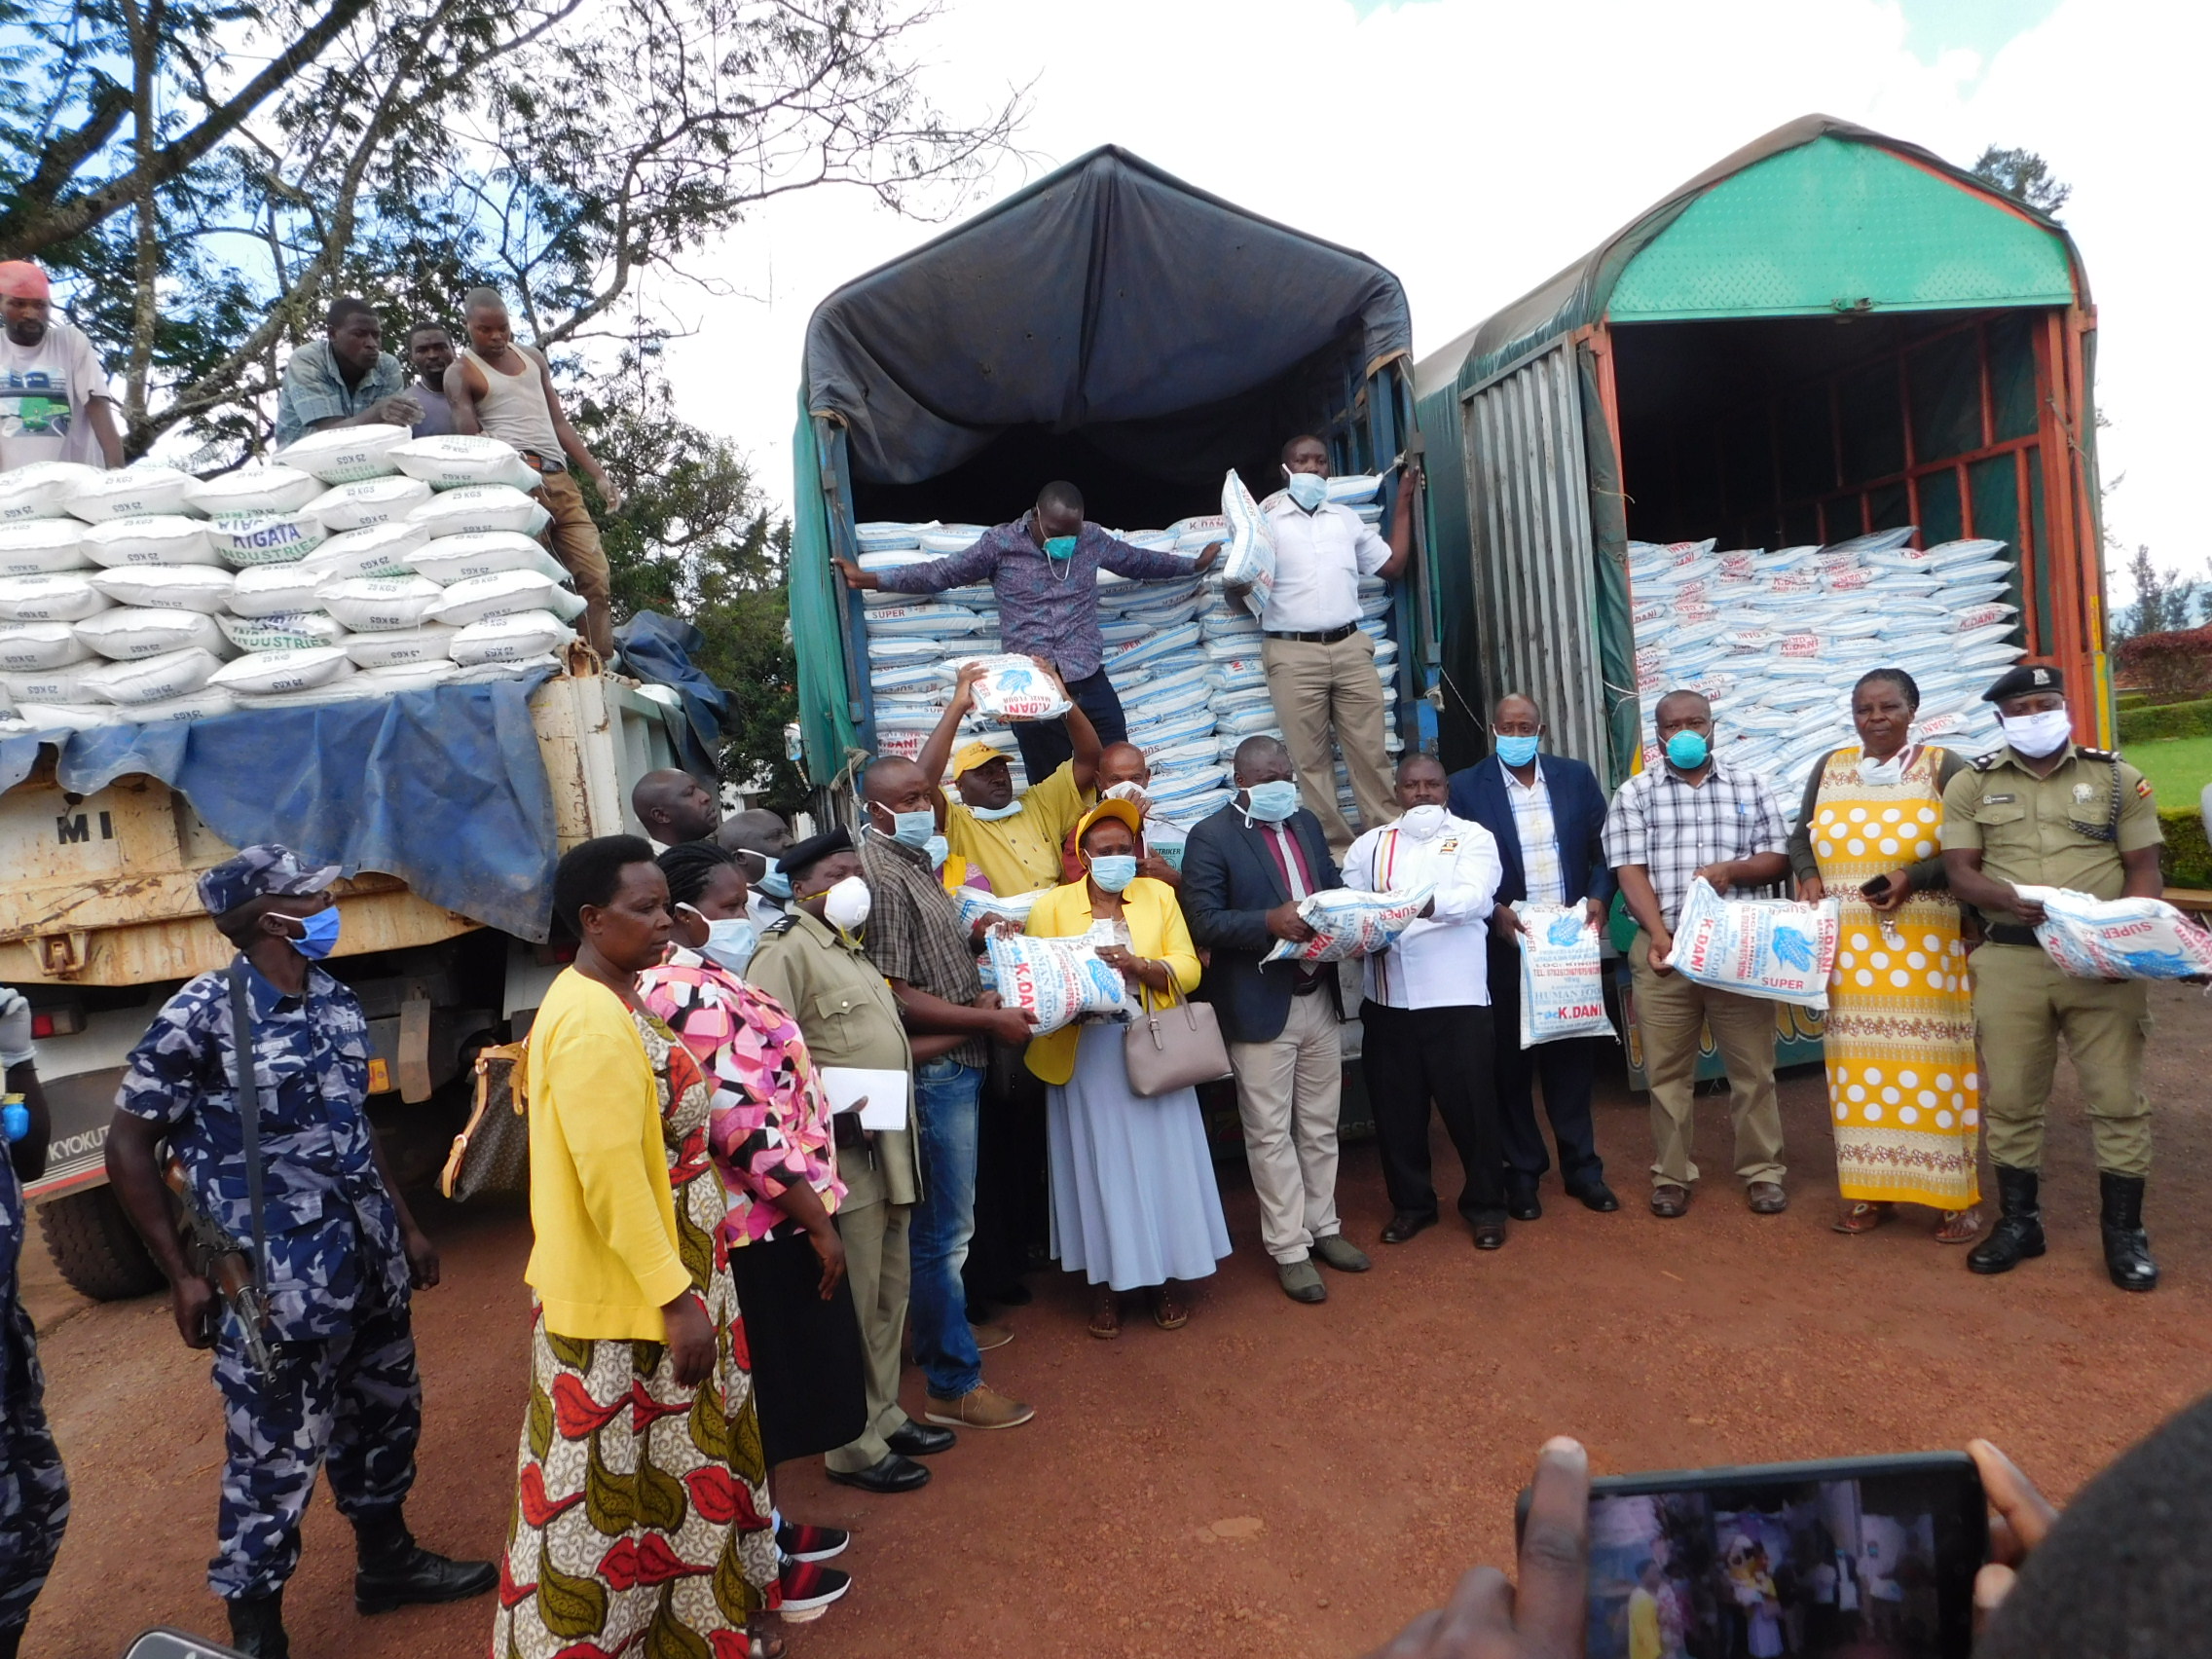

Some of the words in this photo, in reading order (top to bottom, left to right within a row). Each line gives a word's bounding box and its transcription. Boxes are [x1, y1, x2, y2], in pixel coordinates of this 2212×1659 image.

[337, 456, 354, 465] KGS
[355, 454, 366, 462] 25
[358, 486, 375, 495] KGS
[453, 491, 462, 499] 25
[22, 505, 34, 514] 25
[112, 504, 130, 513] KGS
[131, 501, 143, 510] 25
[4, 508, 20, 518] KGS
[359, 516, 378, 525] KGS
[379, 514, 389, 523] 25
[128, 553, 146, 562] KGS
[379, 555, 390, 565] 25
[360, 559, 378, 571] KGS
[872, 609, 905, 619] SUPER
[370, 615, 387, 625] KGS
[1959, 611, 1996, 628] K.DANI
[129, 645, 150, 653] KGS
[391, 650, 409, 659] KGS
[27, 685, 47, 695] KGS
[49, 685, 58, 694] 25
[142, 686, 162, 697] KGS
[162, 683, 173, 693] 25
[1379, 904, 1419, 921] SUPER
[2103, 921, 2153, 940] SUPER
[1690, 917, 1714, 972] K.DANI
[1821, 918, 1834, 974] K.DANI
[1762, 977, 1804, 989] SUPER
[1558, 1004, 1603, 1019] K.DANI
